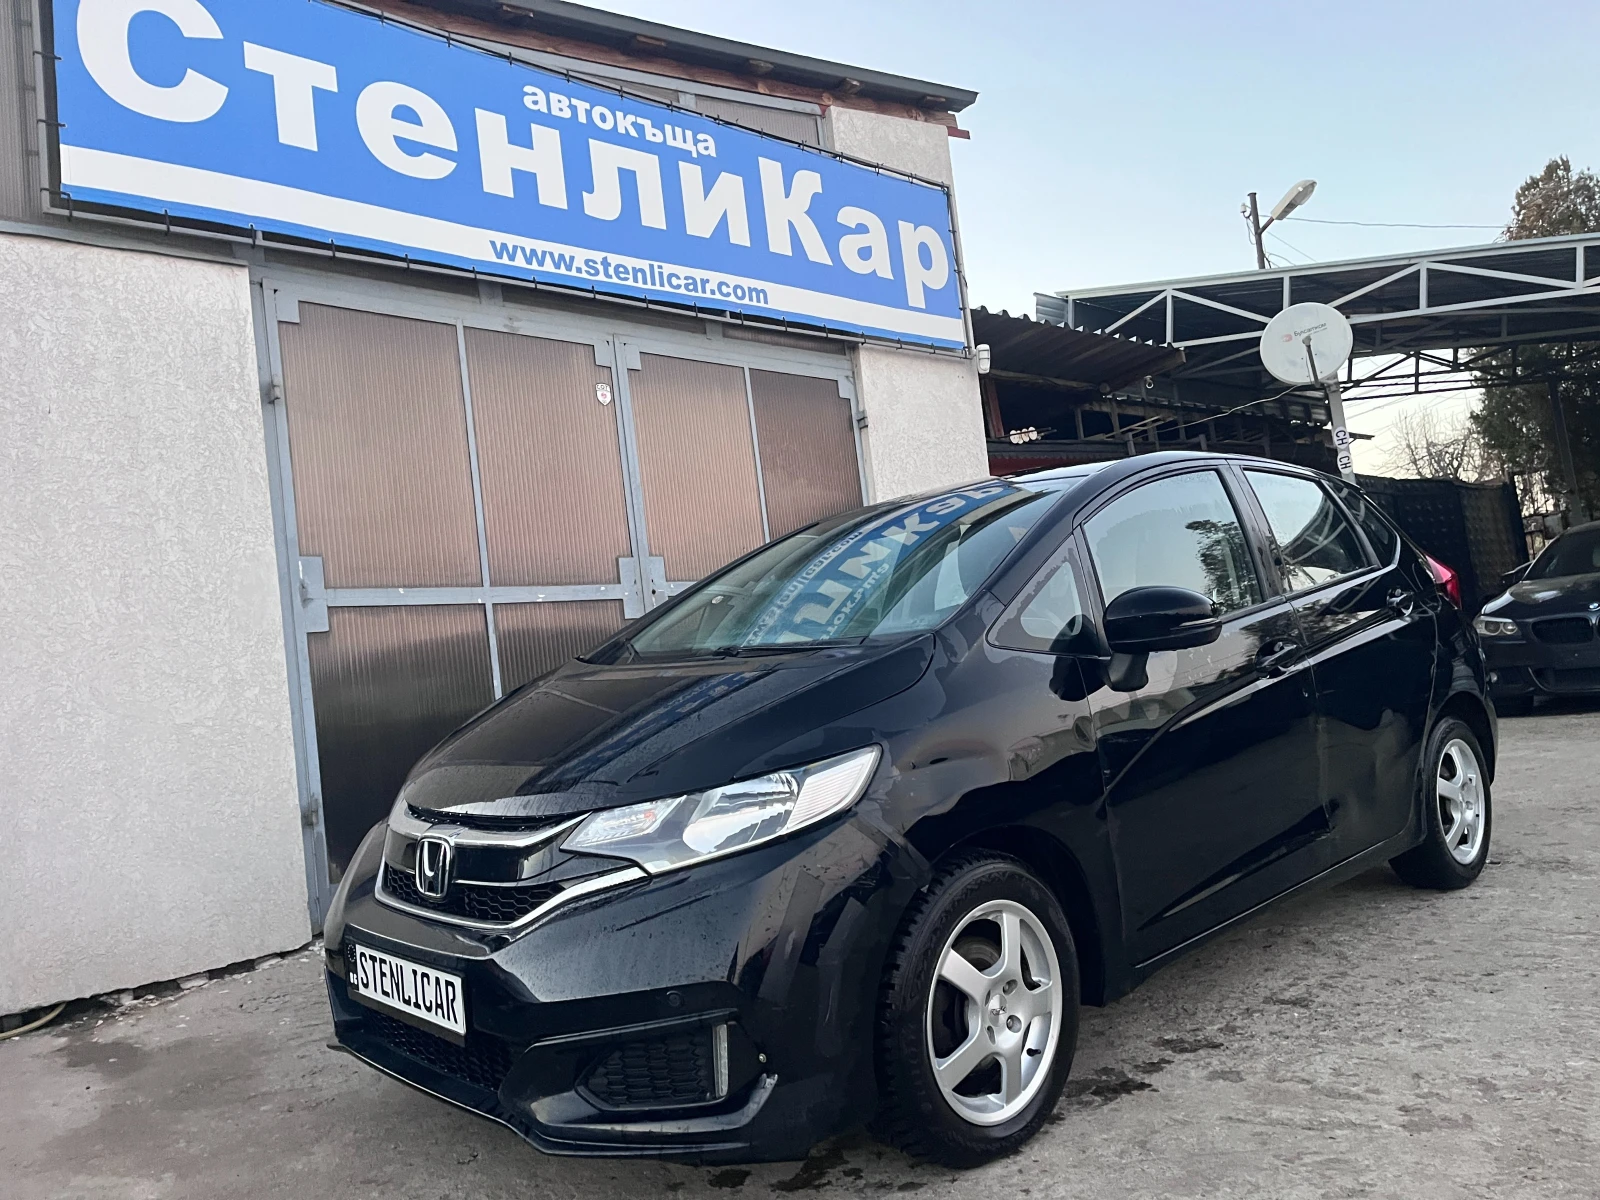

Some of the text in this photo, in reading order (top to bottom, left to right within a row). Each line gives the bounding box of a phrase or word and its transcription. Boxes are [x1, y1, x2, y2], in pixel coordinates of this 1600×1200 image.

[75, 0, 949, 309] СтенлиКар
[523, 84, 717, 159] автокъща
[490, 238, 769, 306] www.stenlicar.com
[1335, 430, 1348, 446] CH
[1339, 455, 1352, 470] CH
[359, 951, 458, 1024] STENLICAR
